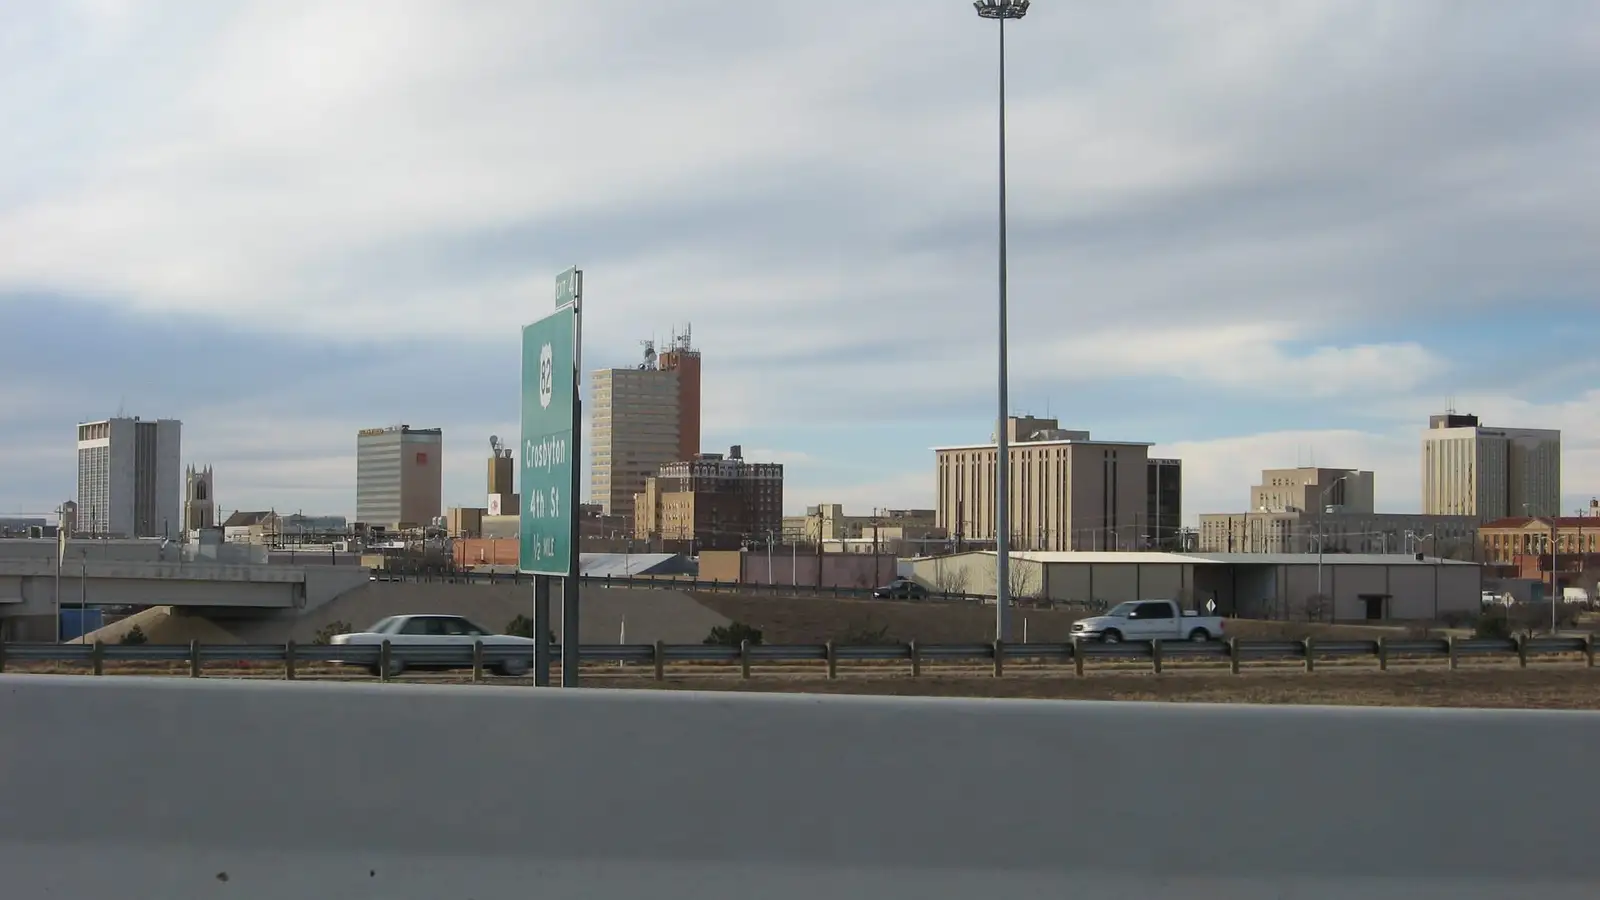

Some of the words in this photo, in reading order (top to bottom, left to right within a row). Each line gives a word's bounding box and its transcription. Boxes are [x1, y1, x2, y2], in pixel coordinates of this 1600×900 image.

[569, 272, 574, 297] 4
[541, 358, 551, 395] 82
[526, 435, 565, 473] Crosbyton
[530, 489, 544, 518] 4th
[551, 486, 559, 518] St
[543, 537, 555, 557] MILE
